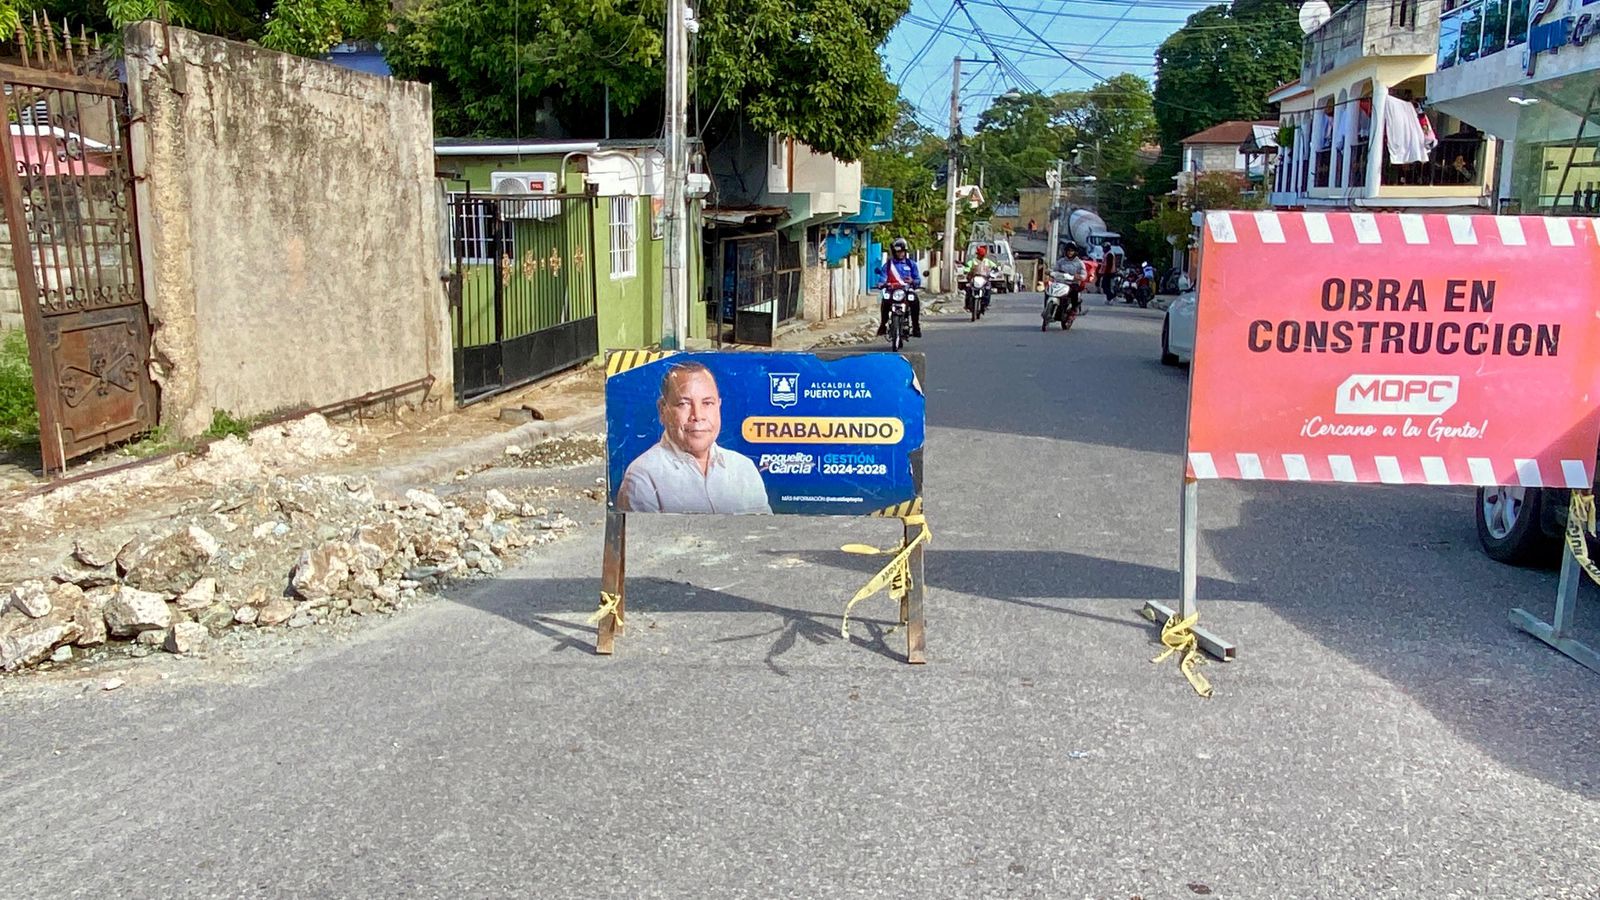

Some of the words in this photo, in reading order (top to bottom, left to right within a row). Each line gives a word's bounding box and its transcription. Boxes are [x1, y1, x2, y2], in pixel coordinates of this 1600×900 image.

[1321, 277, 1427, 312] OBRA
[1444, 279, 1497, 313] EN
[1248, 319, 1562, 357] CONSTRUCCION
[804, 389, 840, 399] PUERTO
[843, 389, 872, 399] PLATA
[1349, 379, 1453, 403] MOPC
[754, 422, 894, 439] TRABAJANDO
[1300, 416, 1376, 437] ¡Cercano
[1382, 426, 1397, 436] a
[1402, 418, 1422, 437] la
[1427, 417, 1489, 442] Gente!
[823, 452, 875, 464] GESTIÓN
[823, 464, 887, 475] 2024-2028
